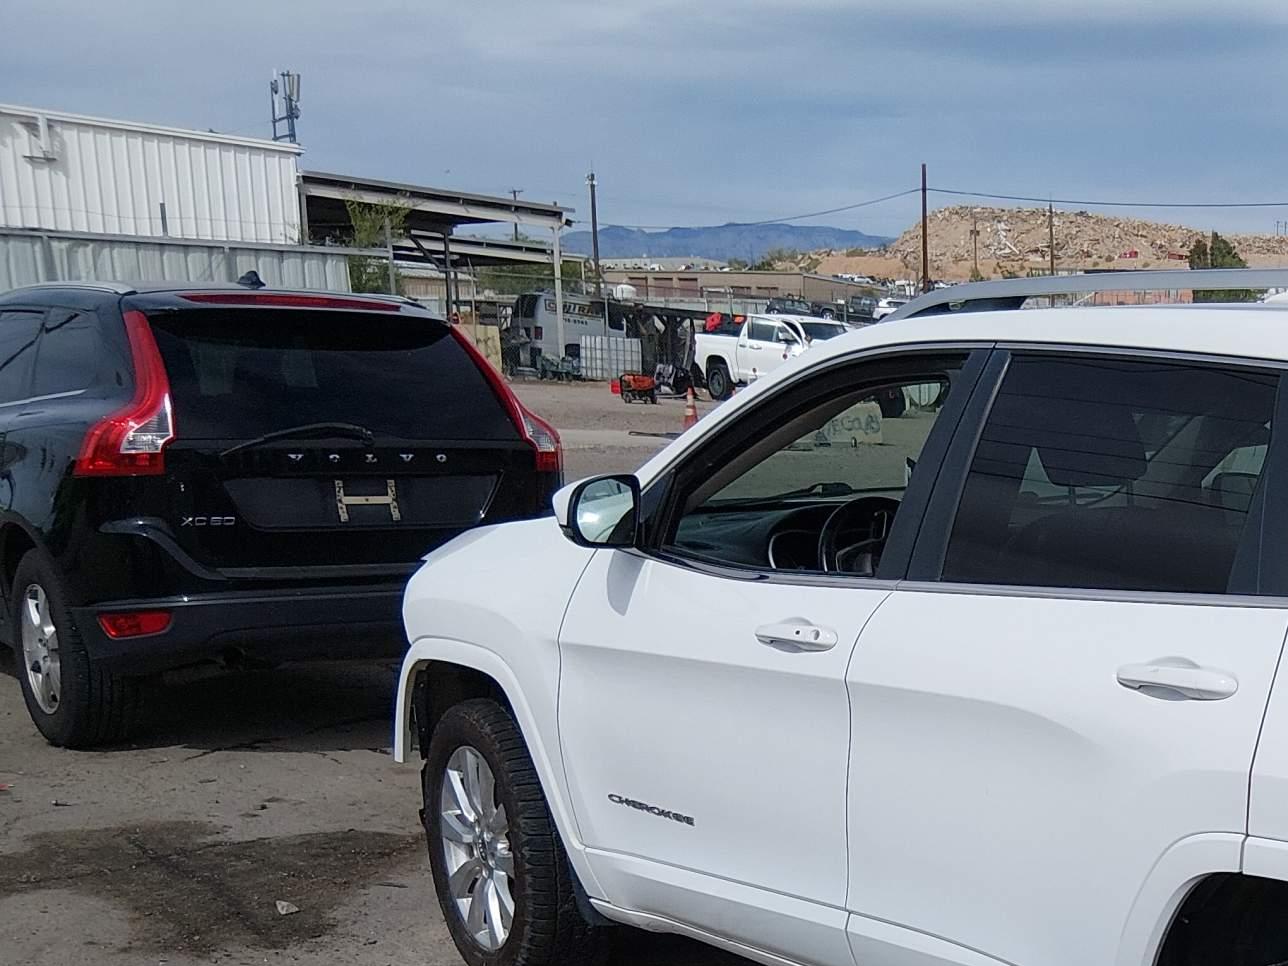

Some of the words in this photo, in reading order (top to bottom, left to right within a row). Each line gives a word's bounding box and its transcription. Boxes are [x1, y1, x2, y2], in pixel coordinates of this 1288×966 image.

[287, 453, 448, 464] VOLVO
[180, 516, 236, 527] XC60
[607, 793, 695, 827] CHEROKEE
